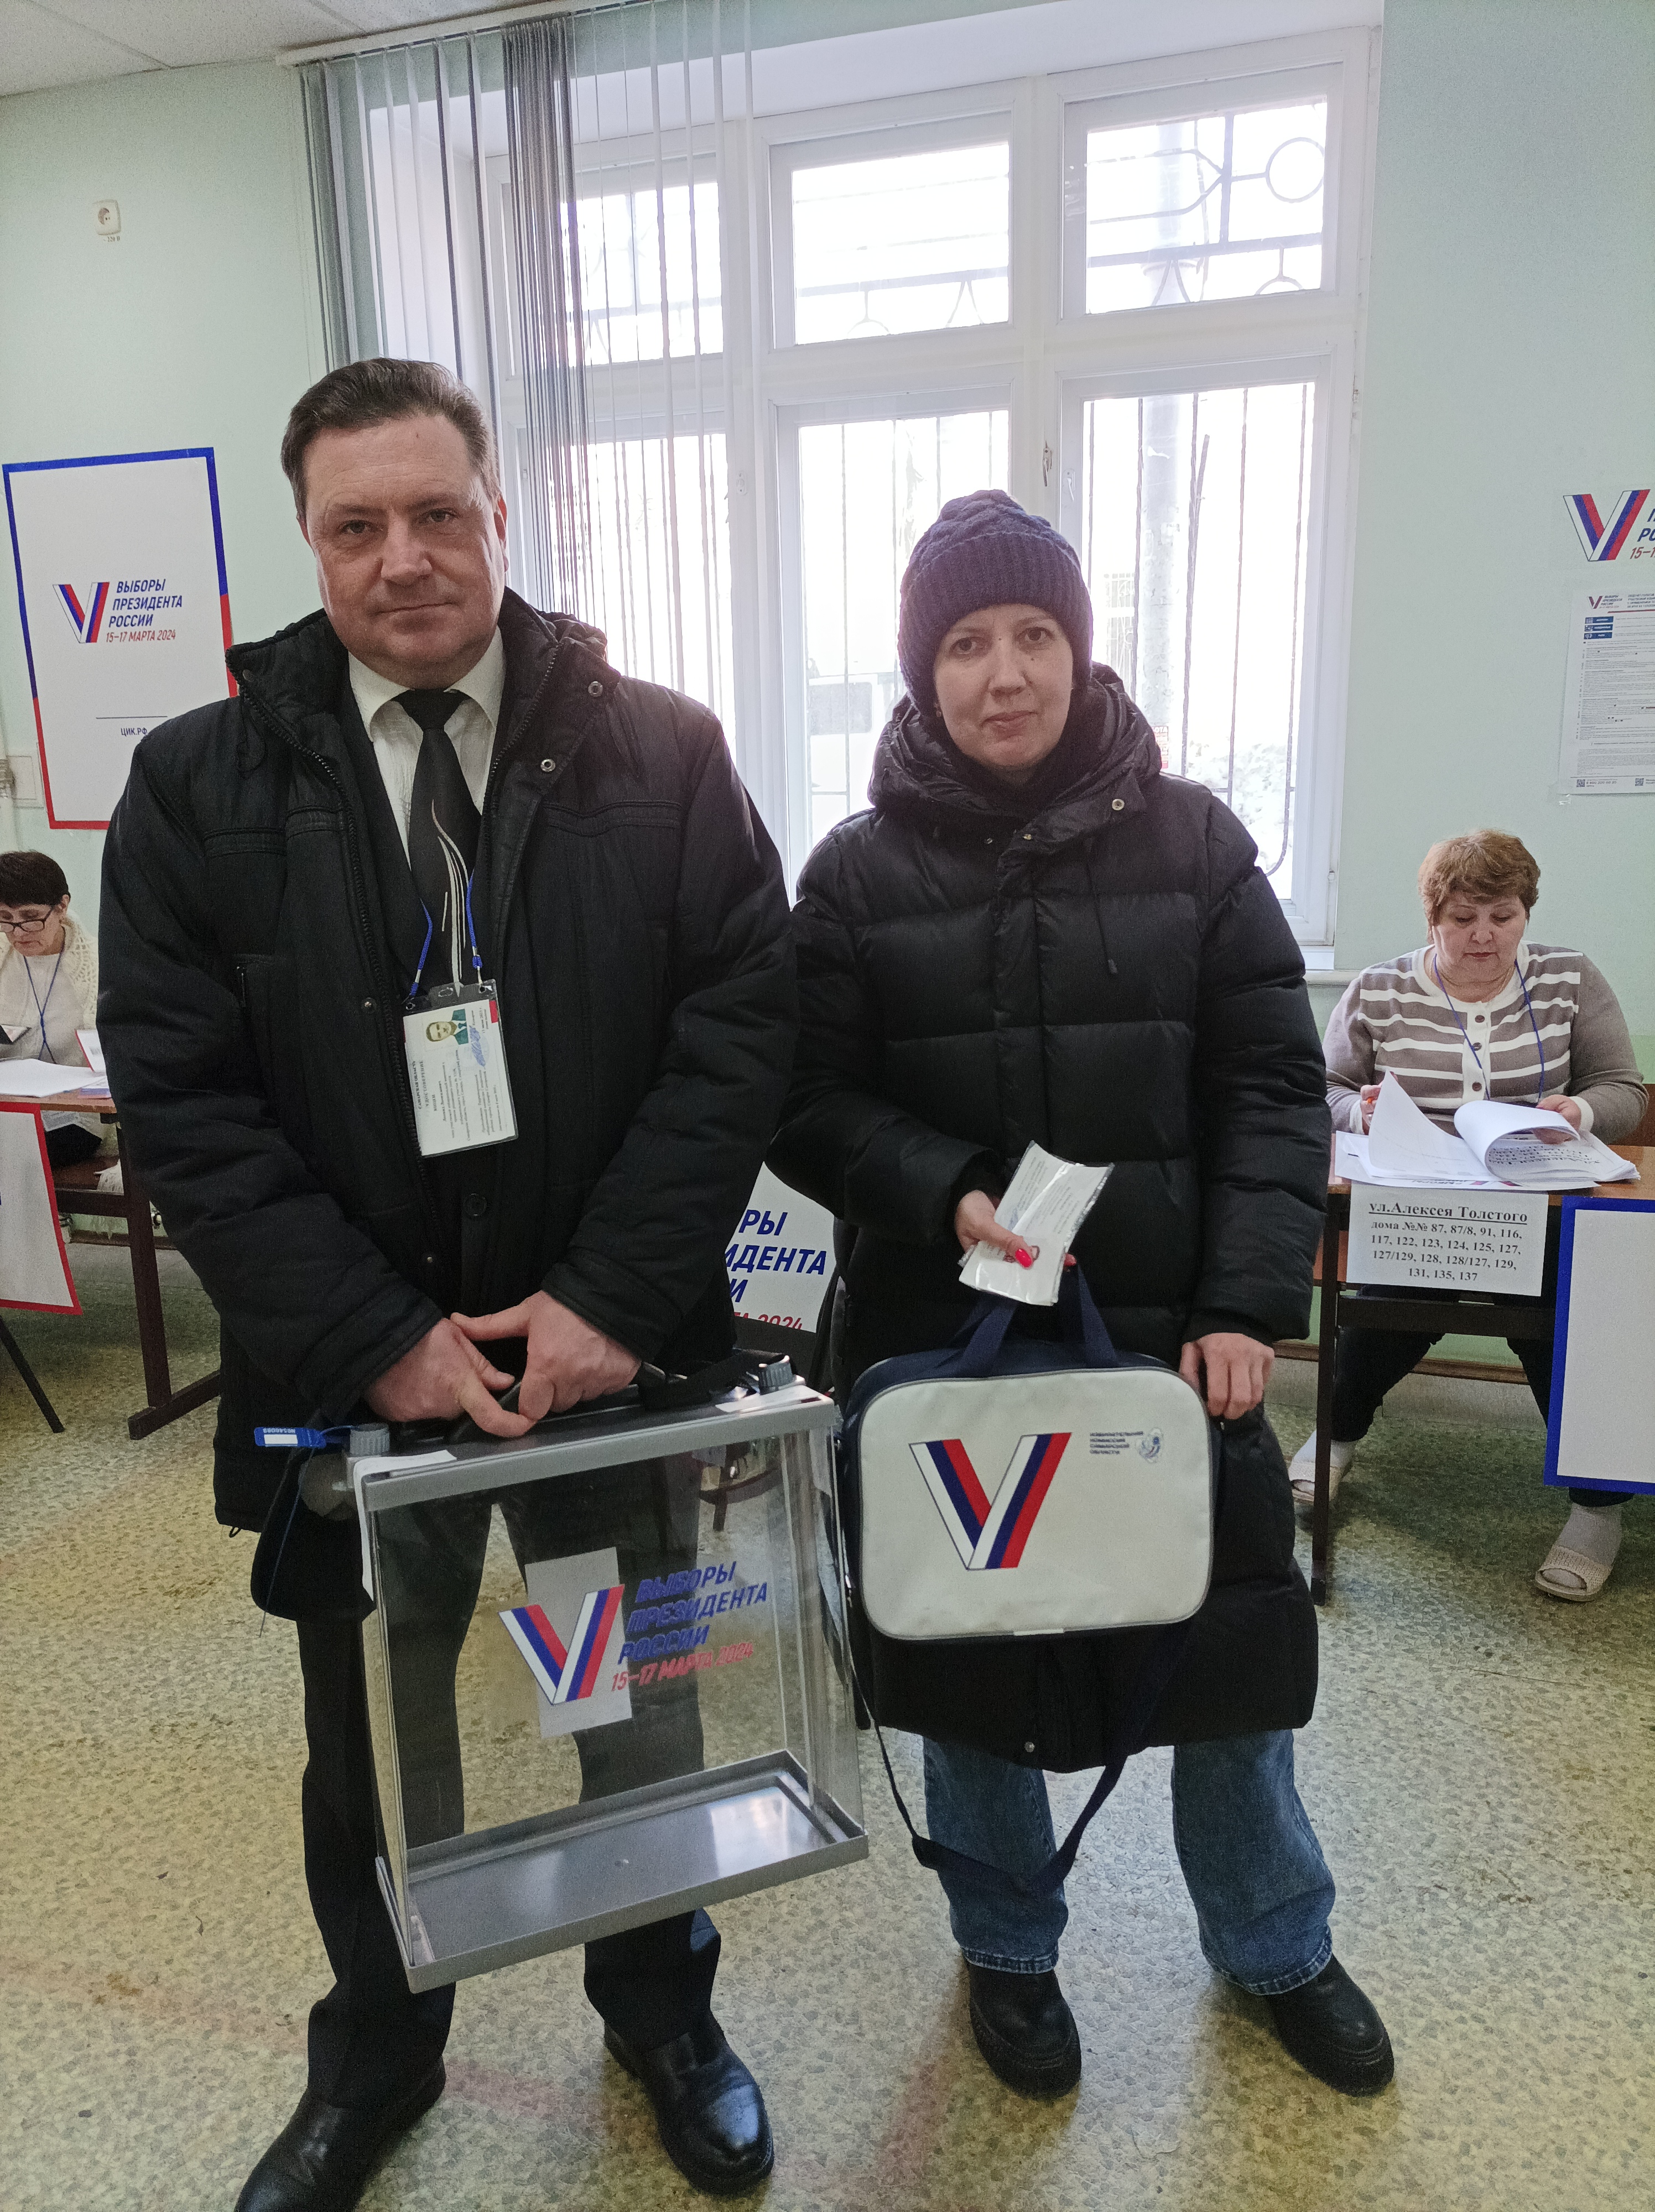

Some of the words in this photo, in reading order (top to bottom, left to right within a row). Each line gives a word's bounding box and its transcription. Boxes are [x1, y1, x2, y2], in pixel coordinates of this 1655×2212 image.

[116, 578, 166, 593] ВЫБОРЫ
[112, 595, 183, 611] ПРЕЗИДЕНТА
[108, 614, 153, 628] РОССИИ
[128, 630, 155, 642] МАРТА
[157, 629, 176, 641] 2024
[121, 727, 148, 737] ЦИК.РФ
[1369, 1202, 1453, 1217] ул.Алексея
[1458, 1206, 1528, 1222] Толстого
[1371, 1221, 1399, 1230] дома
[1431, 1223, 1447, 1234] 87,
[1450, 1225, 1476, 1237] 87/8,
[1480, 1227, 1496, 1238] 91,
[1501, 1229, 1522, 1239] 116,
[1372, 1234, 1393, 1245] 117,
[1397, 1237, 1418, 1248] 122,
[1422, 1238, 1443, 1249] 123,
[1448, 1240, 1469, 1251] 124,
[1474, 1242, 1495, 1253] 125,
[1500, 1244, 1521, 1255] 127,
[1373, 1250, 1417, 1262] 127/129,
[1421, 1254, 1442, 1265] 128,
[1446, 1255, 1491, 1268] 128/127,
[1495, 1259, 1517, 1271] 129,
[1409, 1268, 1430, 1279] 131,
[1434, 1270, 1455, 1281] 135,
[1460, 1271, 1478, 1281] 137
[636, 1561, 737, 1603] ВЫБОРЫ
[626, 1582, 768, 1632] ПРЕЗИДЕНТА
[617, 1624, 710, 1665] РОССИИ
[657, 1650, 713, 1682] МАРТА
